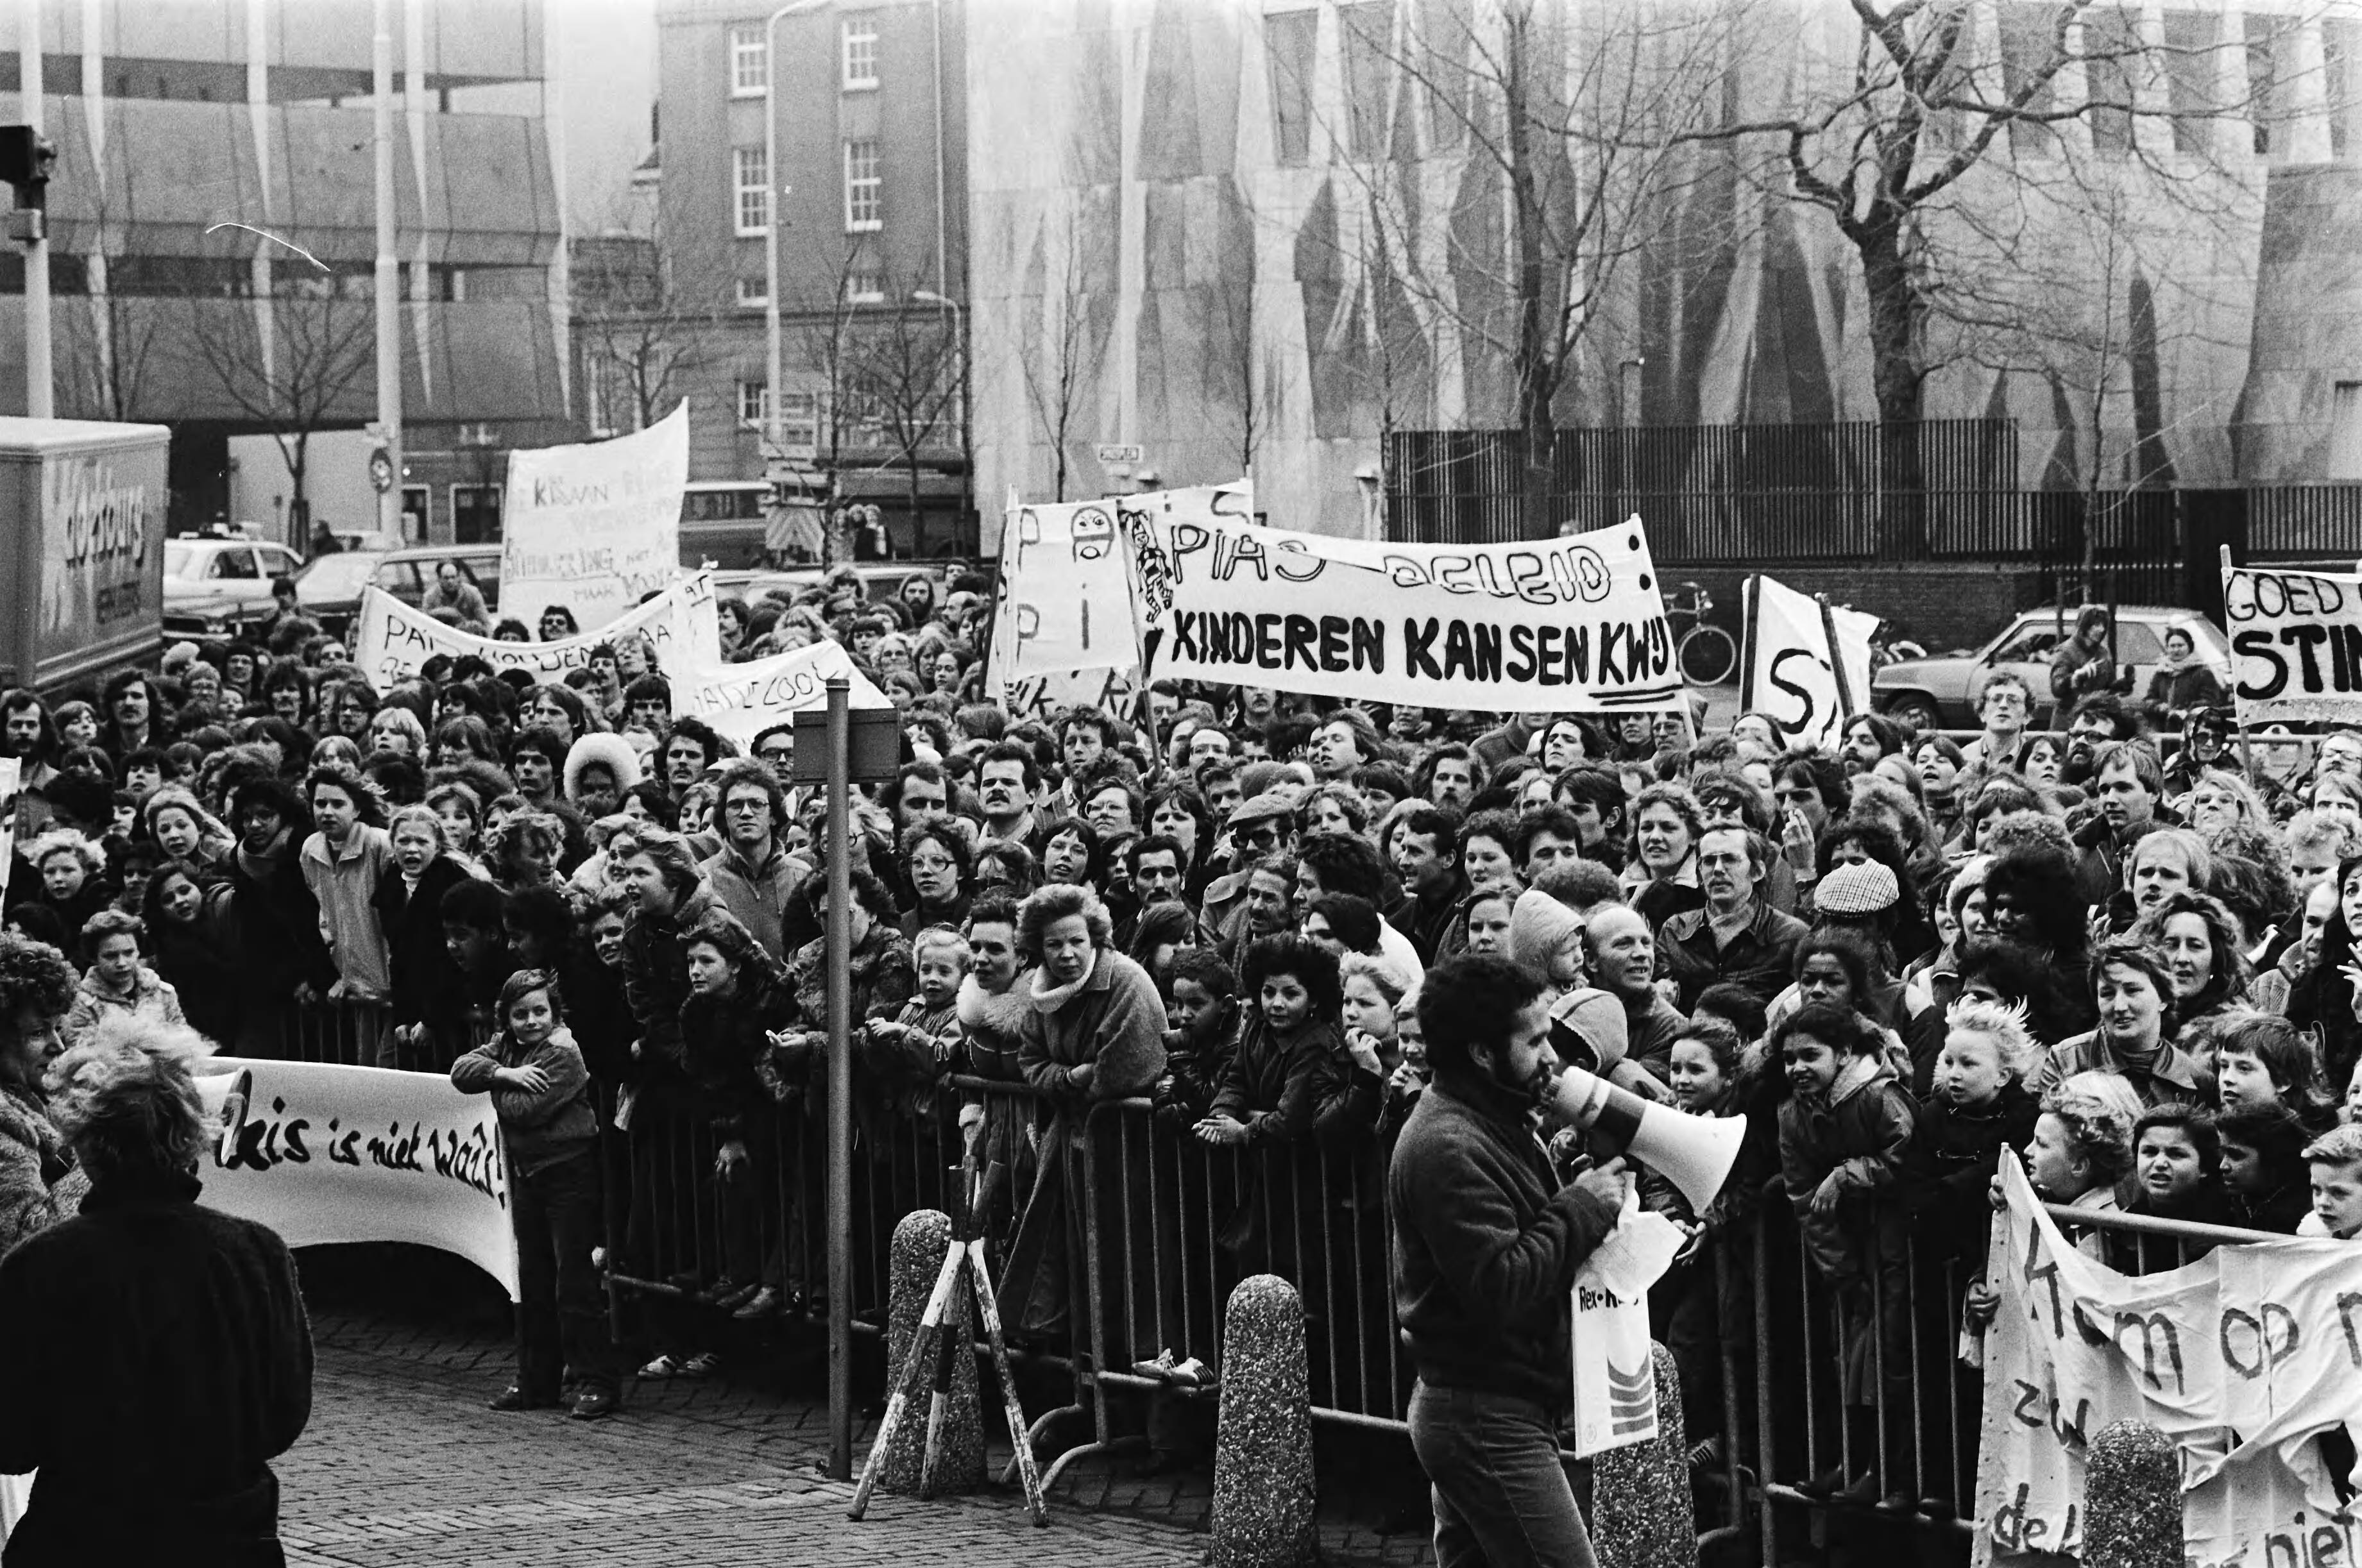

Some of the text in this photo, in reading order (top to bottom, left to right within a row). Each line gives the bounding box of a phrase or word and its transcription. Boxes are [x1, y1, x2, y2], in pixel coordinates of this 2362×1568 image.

[2225, 569, 2343, 622] GOED
[1171, 609, 1386, 675] KINDEREN
[1404, 616, 1589, 686] KANSEN
[328, 1117, 361, 1166] is
[367, 1121, 423, 1172] niet
